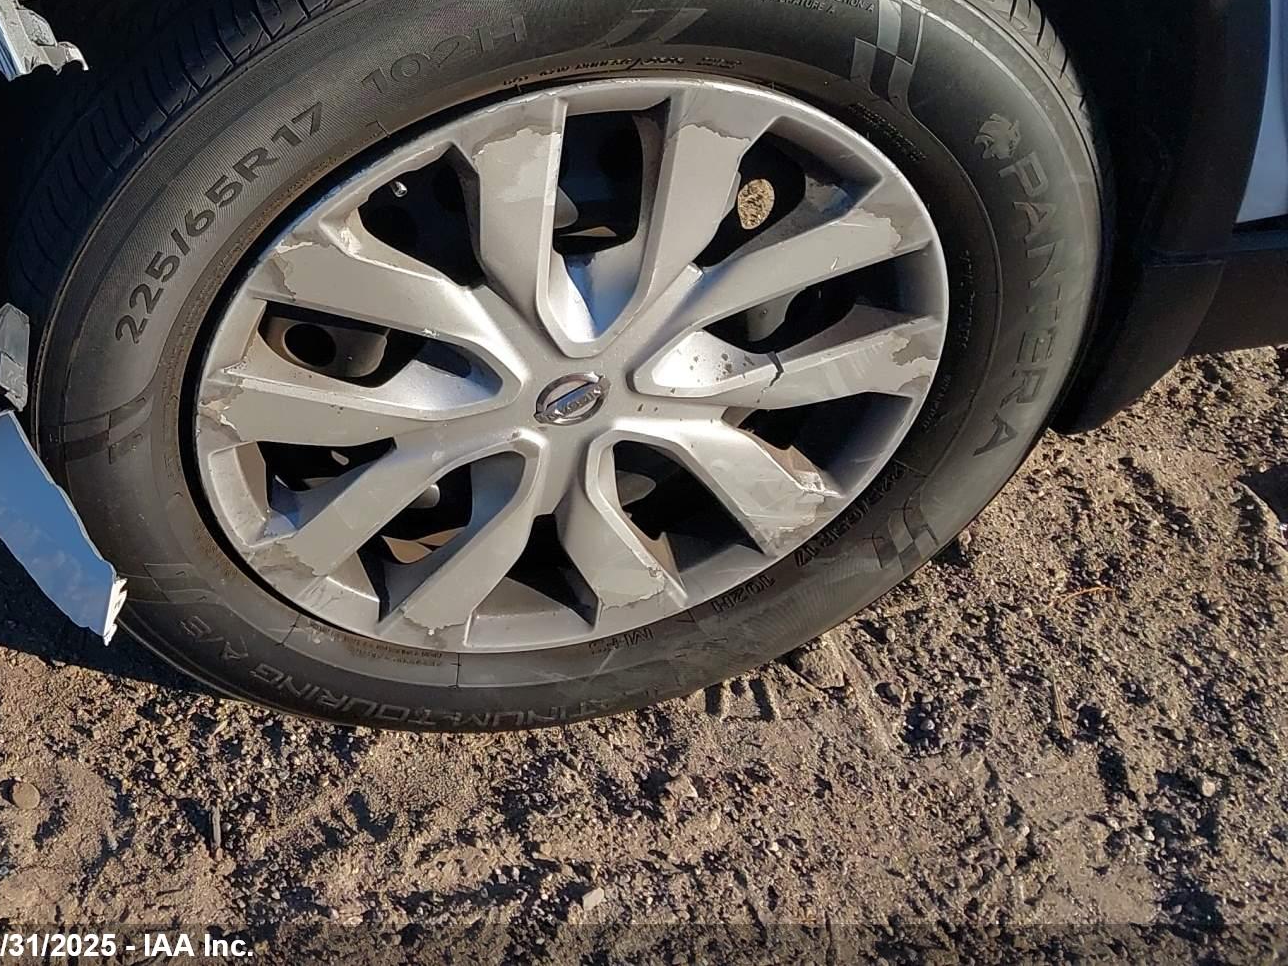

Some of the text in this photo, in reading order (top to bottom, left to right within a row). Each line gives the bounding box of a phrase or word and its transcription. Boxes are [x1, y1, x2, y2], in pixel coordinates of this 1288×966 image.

[115, 11, 529, 346] 225/65R17 102H
[973, 150, 1064, 458] PANTERA
[248, 662, 437, 726] TOURING
